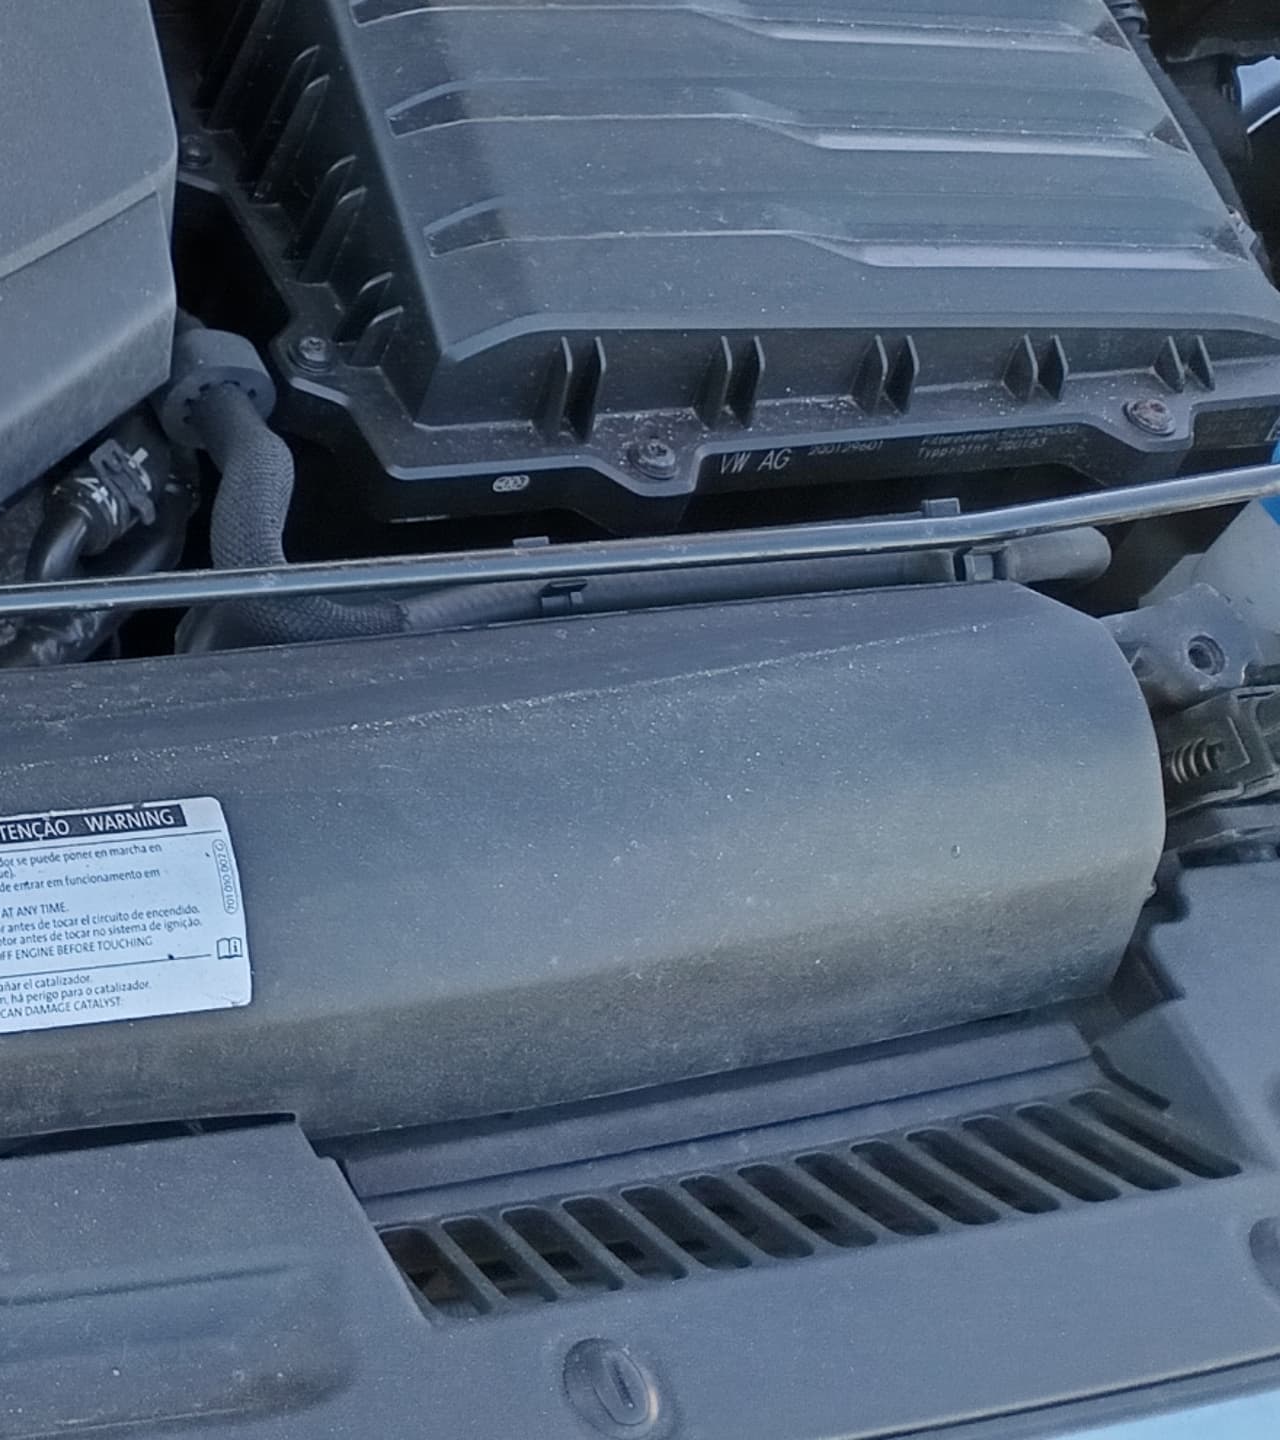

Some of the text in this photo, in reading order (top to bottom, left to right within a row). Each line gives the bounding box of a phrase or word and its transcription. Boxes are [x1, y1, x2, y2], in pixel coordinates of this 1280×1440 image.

[720, 448, 792, 475] VW AG
[83, 808, 175, 833] WARNING
[16, 857, 28, 866] se
[29, 852, 62, 867] puede
[62, 850, 93, 863] poner
[94, 849, 108, 858] en
[108, 843, 148, 856] marcha
[148, 844, 162, 853] en
[13, 880, 45, 892] entrar
[46, 878, 64, 888] em
[64, 869, 143, 887] funcionamento
[143, 868, 160, 879] em
[1, 907, 14, 919] AT
[16, 905, 38, 917] ANY
[7, 921, 36, 933] antes
[37, 919, 51, 931] de
[52, 917, 78, 929] tocar
[80, 914, 90, 926] el
[91, 912, 130, 925] circuito
[130, 909, 145, 921] de
[145, 904, 201, 920] encendido.
[19, 933, 48, 945] antes
[49, 930, 63, 942] de
[64, 929, 91, 940] tocar
[92, 924, 107, 937] no
[107, 923, 148, 936] sistema
[148, 920, 162, 932] de
[163, 916, 202, 932] ignição.
[15, 945, 55, 961] ENGINE
[56, 941, 96, 956] BEFORE
[96, 935, 153, 952] TOUCHING
[10, 992, 24, 1005] há
[25, 990, 59, 1005] perigo
[60, 988, 84, 1002] para
[85, 987, 93, 996] o
[22, 979, 33, 990] el
[0, 1007, 23, 1019] CAN
[24, 1001, 71, 1017] DAMAGE
